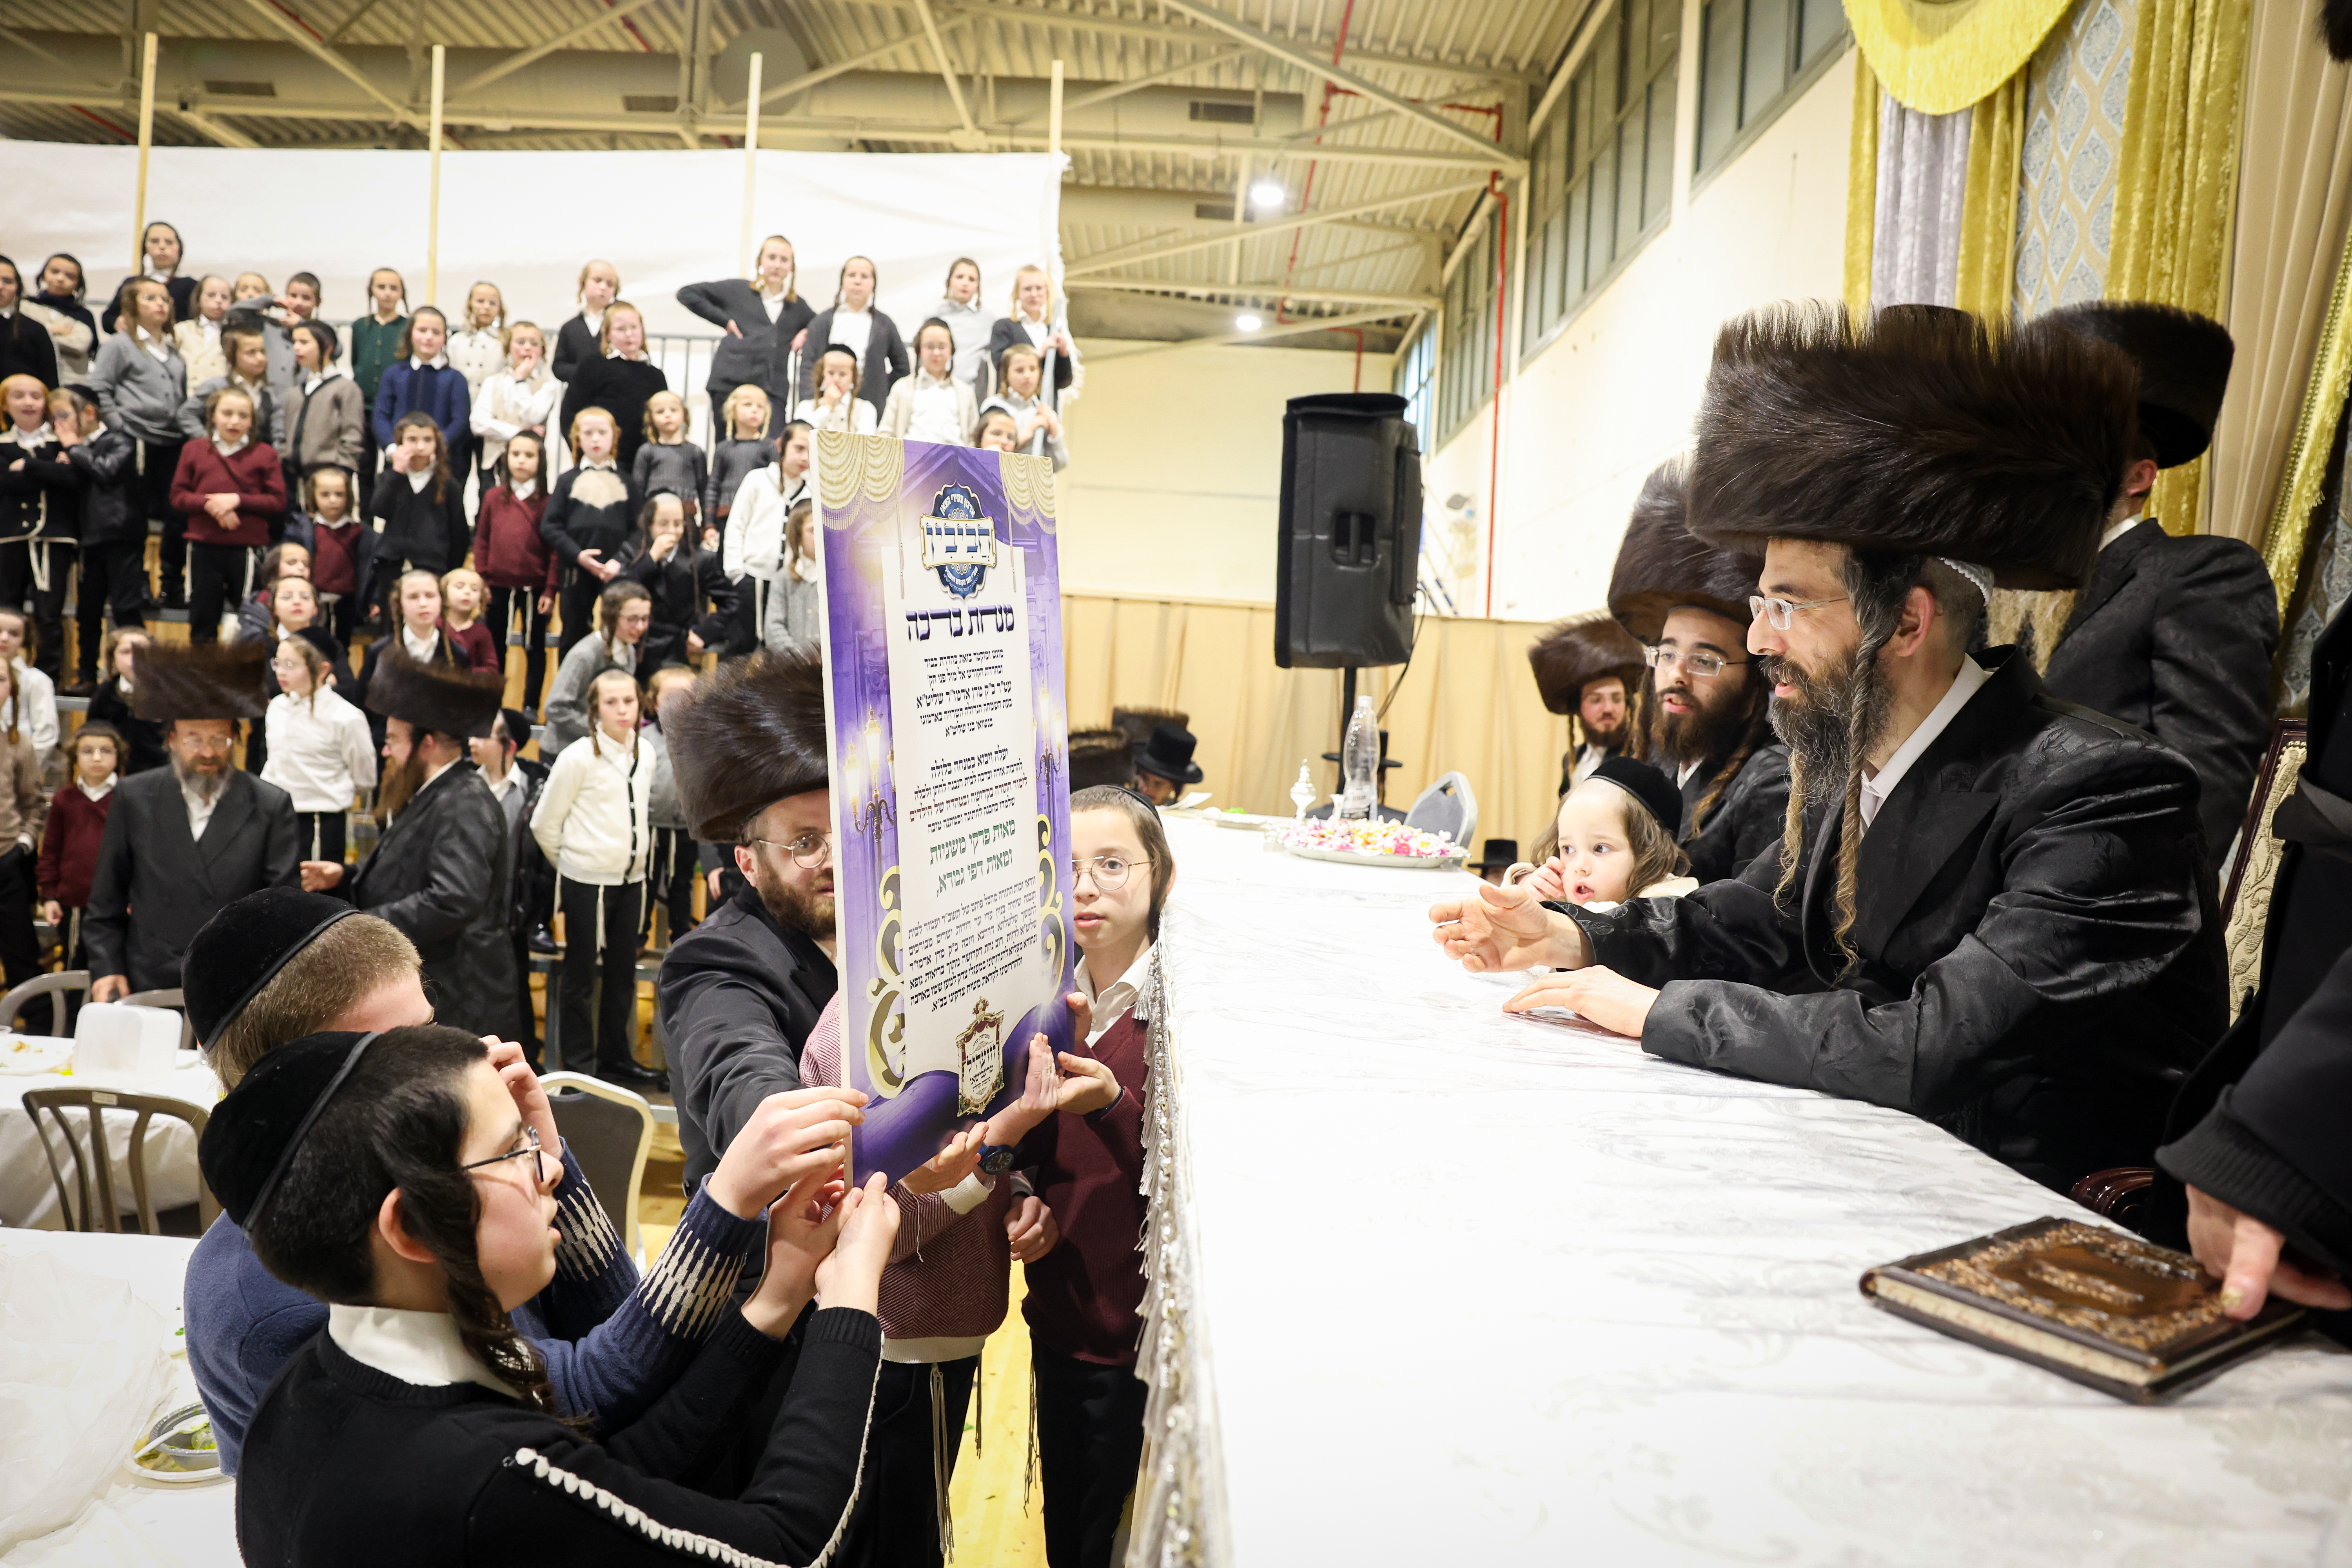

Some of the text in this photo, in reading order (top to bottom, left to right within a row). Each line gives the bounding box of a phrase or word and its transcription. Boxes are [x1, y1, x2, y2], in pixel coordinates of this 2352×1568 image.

[940, 493, 976, 518] ארגון צעירי הצאן
[955, 578, 966, 587] הקודש
[906, 603, 1014, 642] מנחת ברכה
[924, 649, 1004, 668] מוגש ומוקטר בזאת בהדרת כבוד
[938, 673, 946, 684] פני
[946, 668, 957, 682] מול
[957, 666, 965, 680] אל
[967, 668, 984, 680] הקודש
[971, 686, 983, 702] מרן
[920, 698, 1012, 725] בעת השמחה הגדולה השרויה בארמונו
[976, 718, 993, 730] בנשואי
[931, 744, 1008, 779] יעלה ויבוא כמנחה בלולה
[914, 758, 1023, 800] להרבות אורה וברכה לבית הנבנה לחתן ולכלה
[909, 772, 1027, 822] לימוד התורה בקדושה ובטהרה של הילדים
[999, 794, 1015, 809] שלמדו
[964, 804, 982, 822] לחתונה
[983, 802, 998, 815] כהכנה
[927, 820, 942, 833] טובה
[930, 819, 1015, 866] מאות פרקי משניות
[987, 849, 1013, 875] ומאות
[967, 860, 983, 881] דפי
[998, 886, 1013, 900] התורה
[1014, 881, 1024, 893] זכות
[984, 893, 997, 906] מהבל
[1008, 897, 1021, 911] שיהיה
[1024, 891, 1036, 903] הנבנה
[961, 903, 970, 916] של
[971, 899, 983, 912] פיהם
[1021, 902, 1036, 922] להמשך
[974, 915, 981, 926] עד
[984, 910, 993, 921] עדי
[997, 912, 1018, 932] שלשלתא
[908, 921, 922, 940] לבית
[924, 917, 940, 931] יעמוד
[956, 920, 971, 936] דורות
[936, 928, 953, 944] ישרים
[977, 925, 994, 942] דדהבא
[1006, 925, 1019, 943] לרוות
[1023, 934, 1037, 949] ונהורא
[909, 937, 933, 956] מבורכים
[961, 935, 974, 949] ויזכה
[984, 941, 994, 954] נחת
[995, 936, 1003, 948] רוב
[1009, 941, 1023, 956] מעליא
[935, 949, 945, 964] מרן
[962, 946, 982, 965] דקדושה
[925, 965, 945, 983] בריאות
[946, 958, 960, 974] מתוך
[968, 960, 986, 976] במעגלי
[910, 975, 923, 990] גופא
[943, 971, 956, 993] למען
[957, 969, 968, 985] צדק
[982, 966, 998, 986] לקראת
[931, 982, 943, 996] שמו
[966, 979, 981, 994] משיח
[910, 988, 930, 1006] באהבה
[948, 987, 965, 1003] צדקינו
[966, 1043, 996, 1074] זוועהיל
